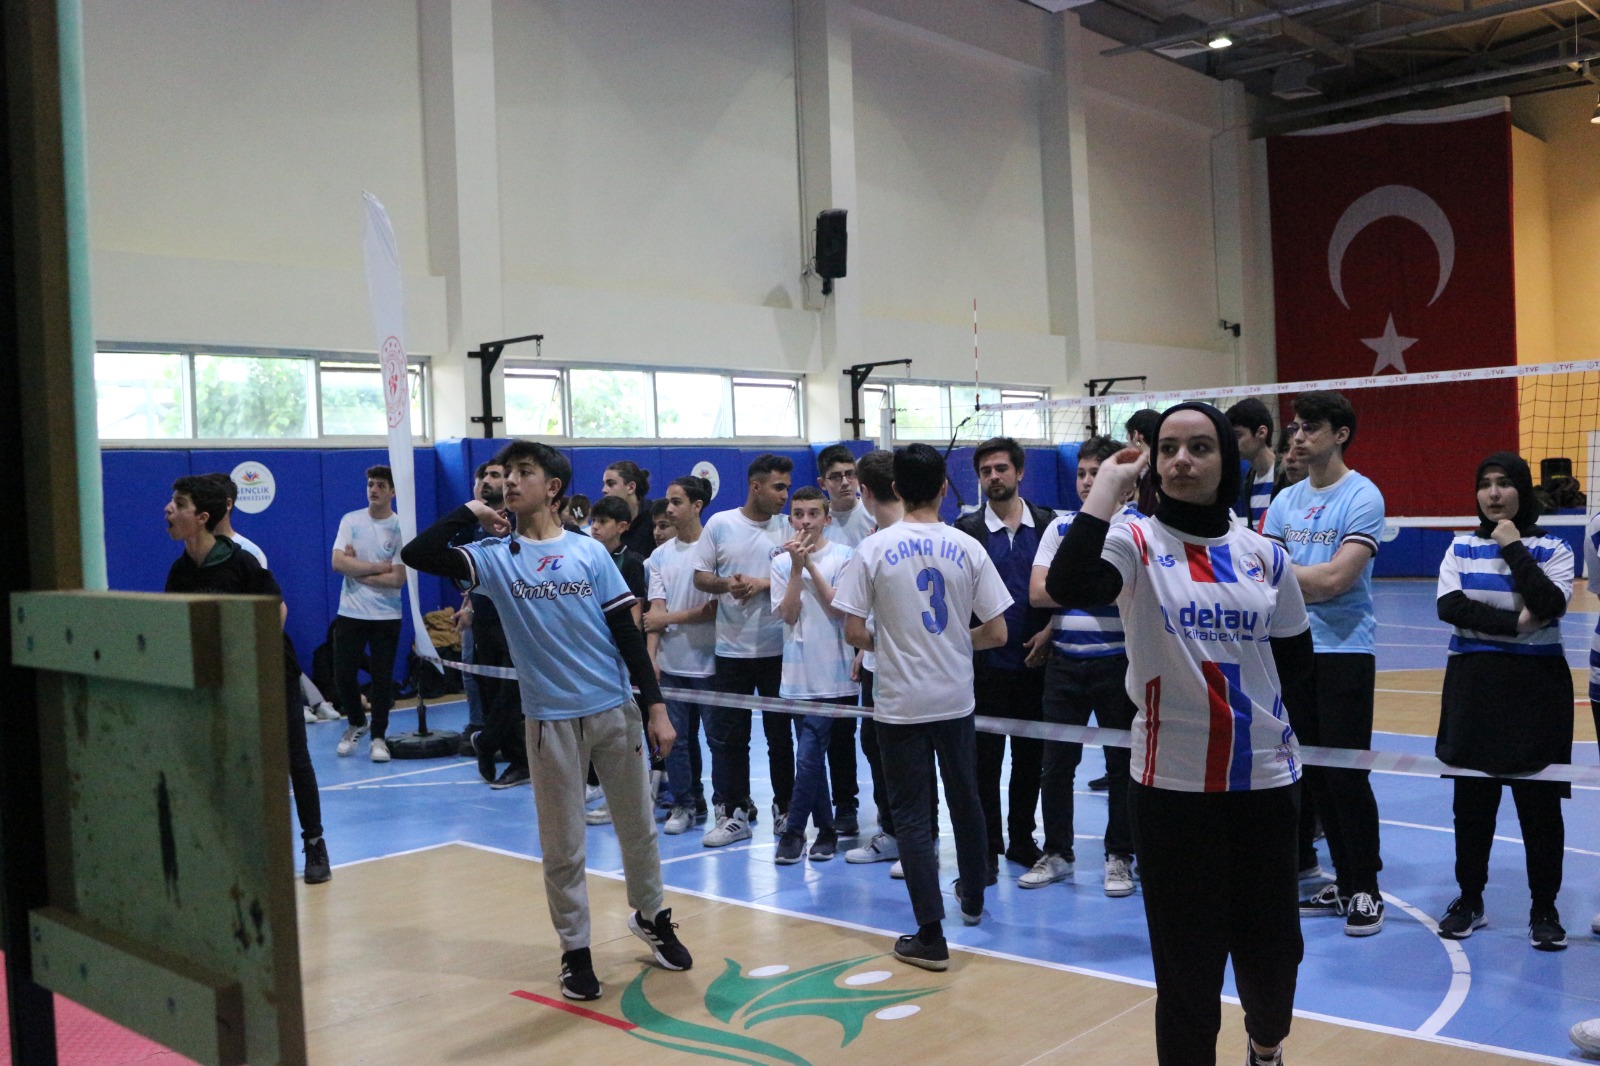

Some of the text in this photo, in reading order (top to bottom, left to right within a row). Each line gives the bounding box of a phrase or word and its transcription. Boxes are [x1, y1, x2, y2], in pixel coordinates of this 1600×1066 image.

[885, 536, 966, 570] GAMA İHL
[512, 580, 592, 600] Ümit usta
[916, 567, 948, 635] 3
[1180, 601, 1258, 632] detay
[1184, 628, 1240, 642] kitabevi
